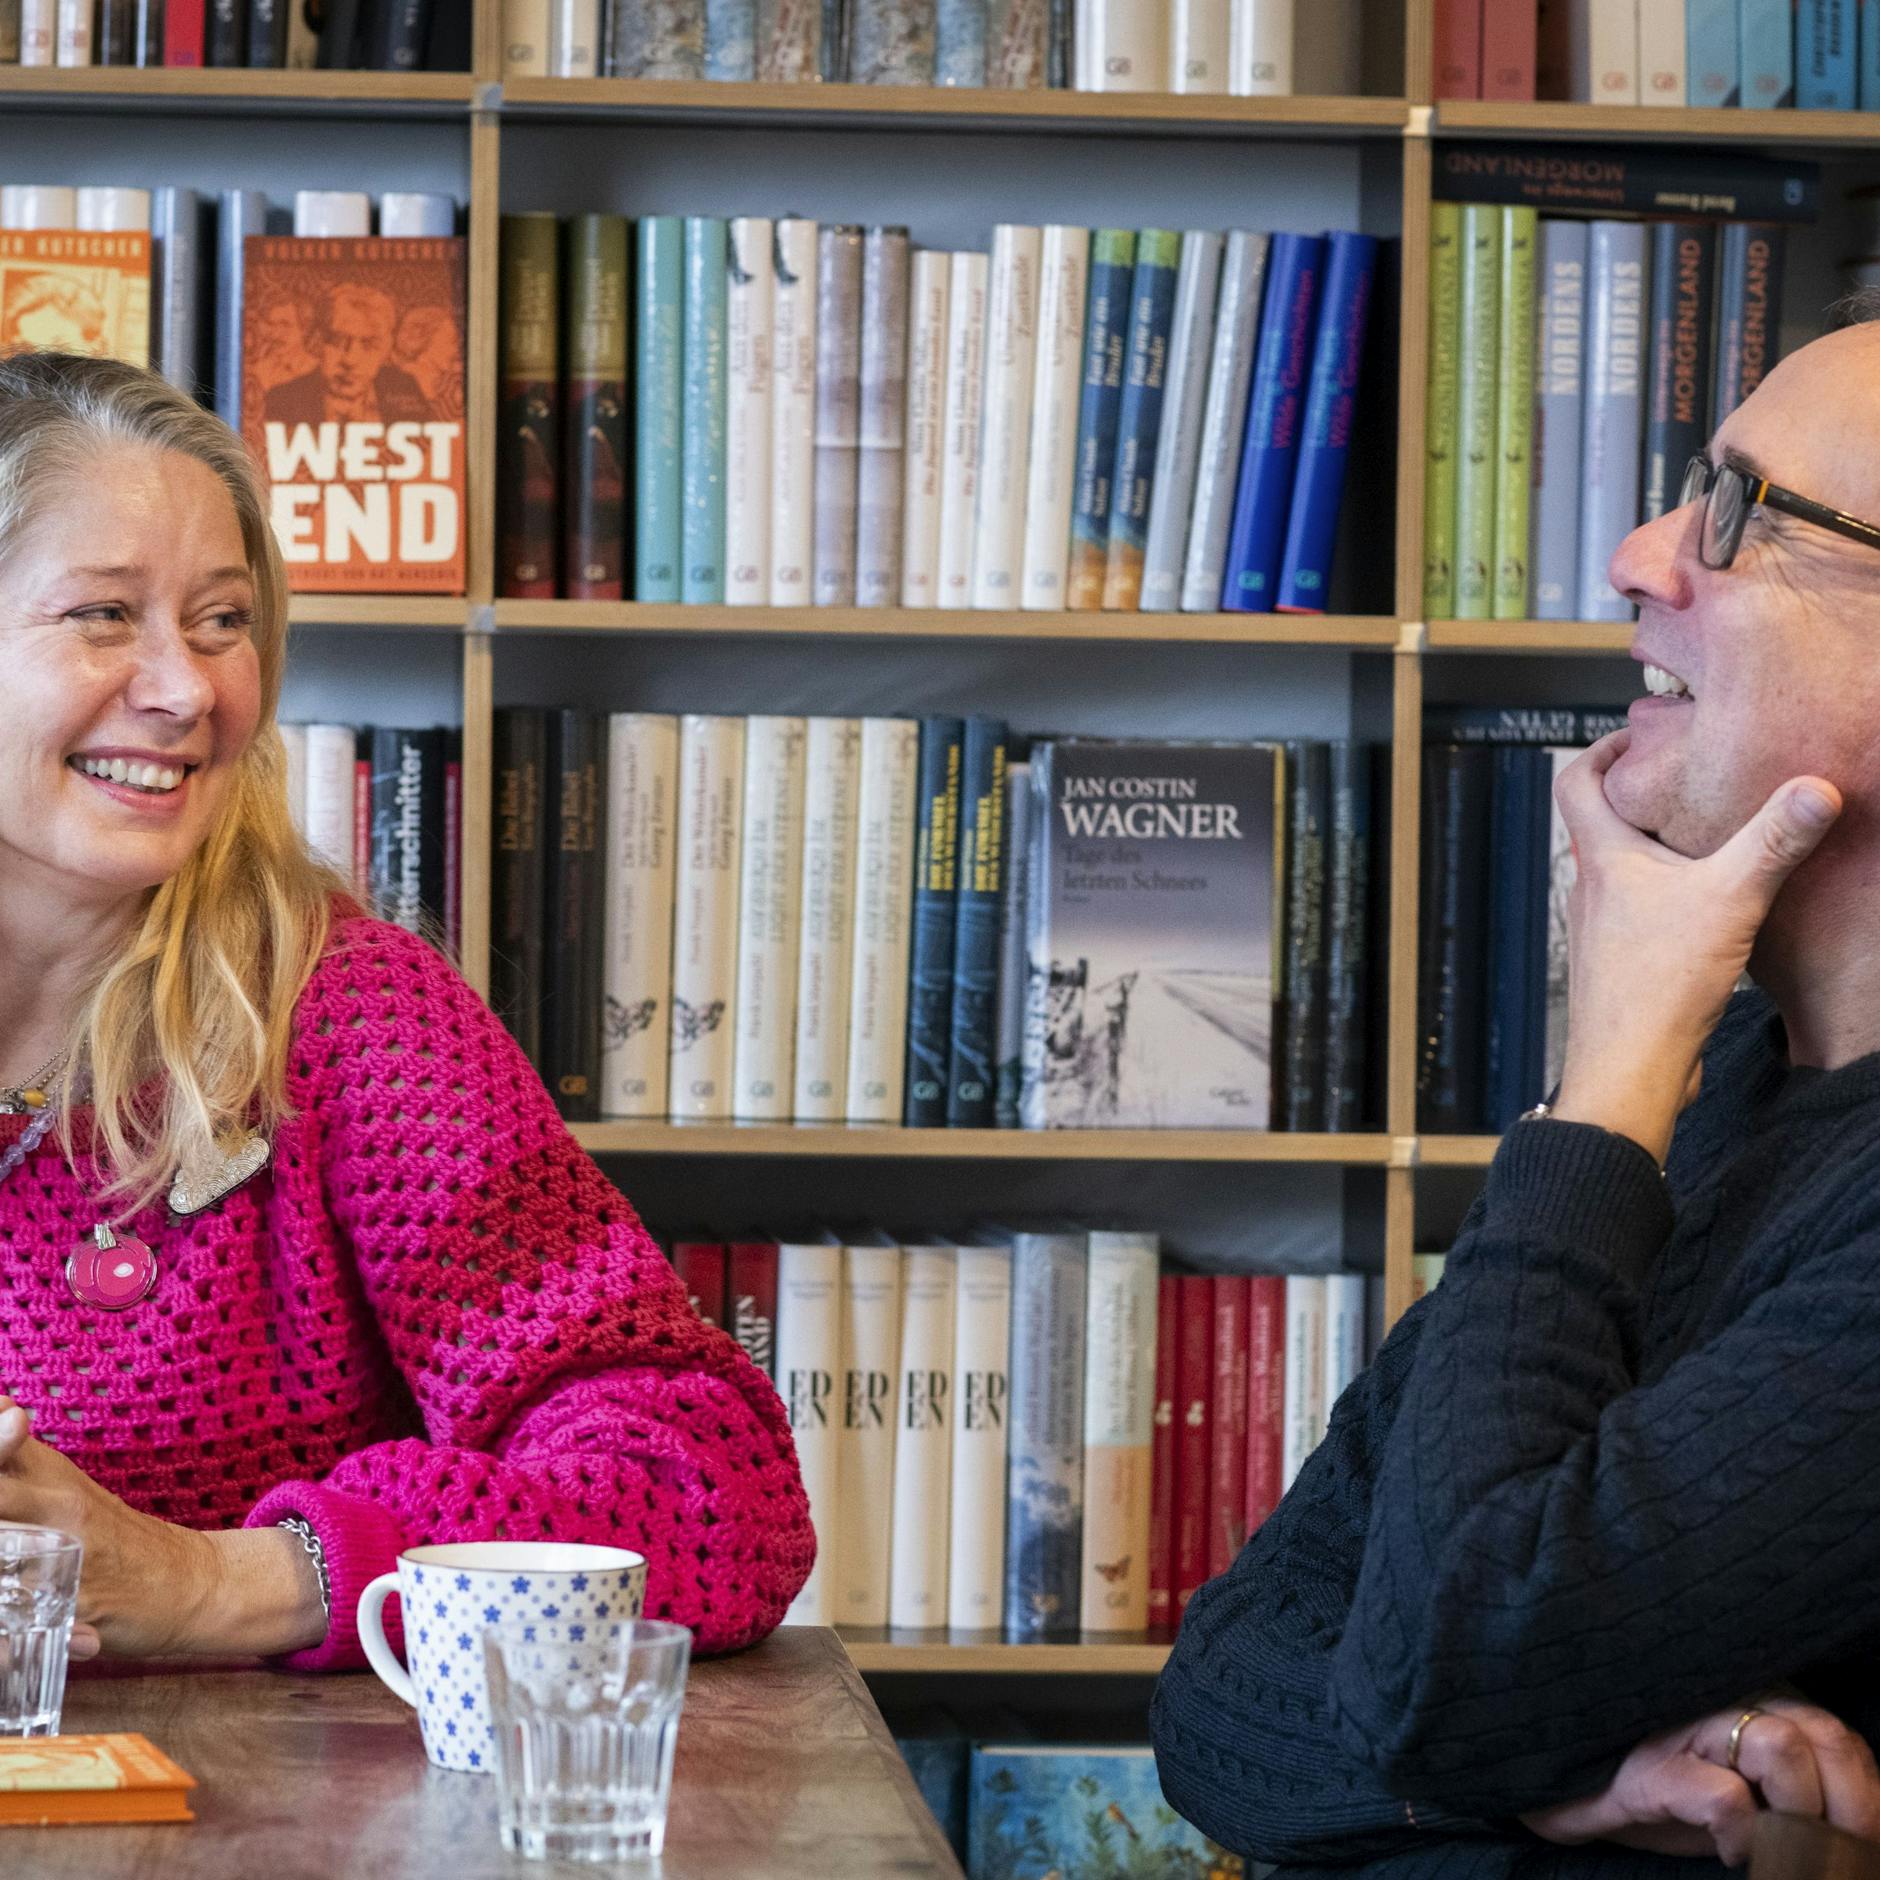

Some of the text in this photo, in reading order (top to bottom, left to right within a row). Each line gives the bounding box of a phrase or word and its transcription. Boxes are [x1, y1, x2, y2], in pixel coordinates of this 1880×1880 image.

[1551, 261, 1582, 396] NORDENS
[1610, 261, 1642, 397] NORDENS
[1673, 239, 1701, 423] MORGENLAND
[1740, 239, 1770, 399] ORGENLAND
[264, 421, 461, 481] WEST
[269, 483, 458, 563] END
[1061, 803, 1243, 839] WAGNER
[1064, 776, 1198, 801] JAN COSTIN
